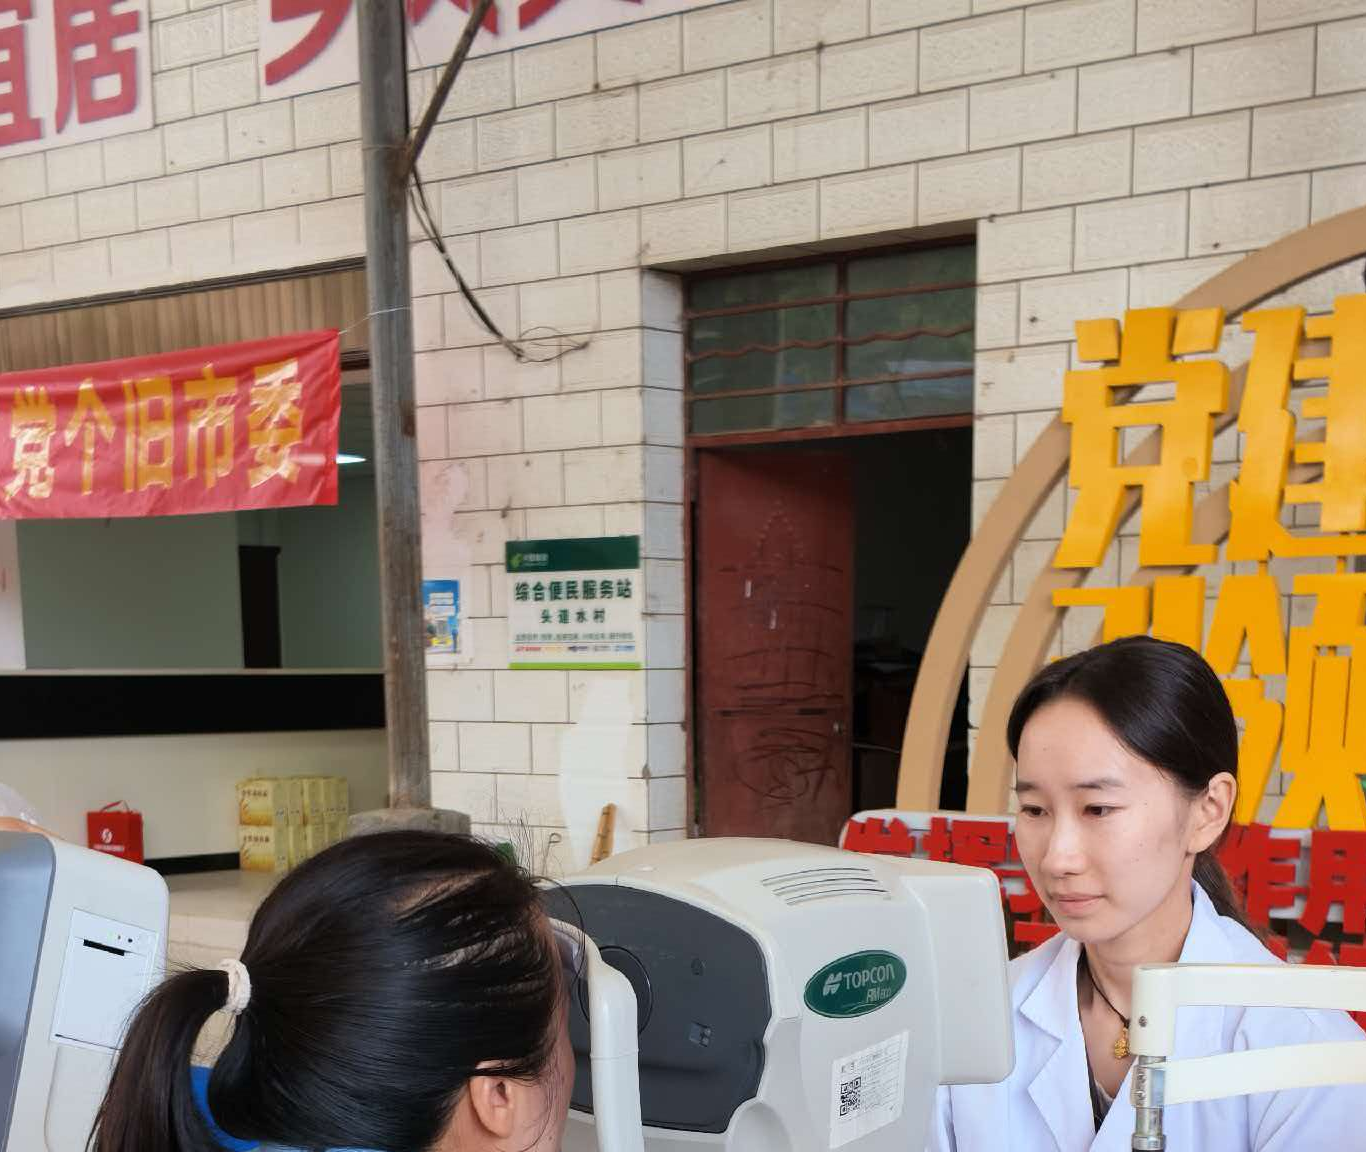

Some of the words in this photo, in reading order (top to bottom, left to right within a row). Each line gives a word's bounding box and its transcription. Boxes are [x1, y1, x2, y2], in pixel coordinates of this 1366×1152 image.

[515, 578, 633, 601] 综合便民服务站
[843, 963, 896, 990] TOPCON
